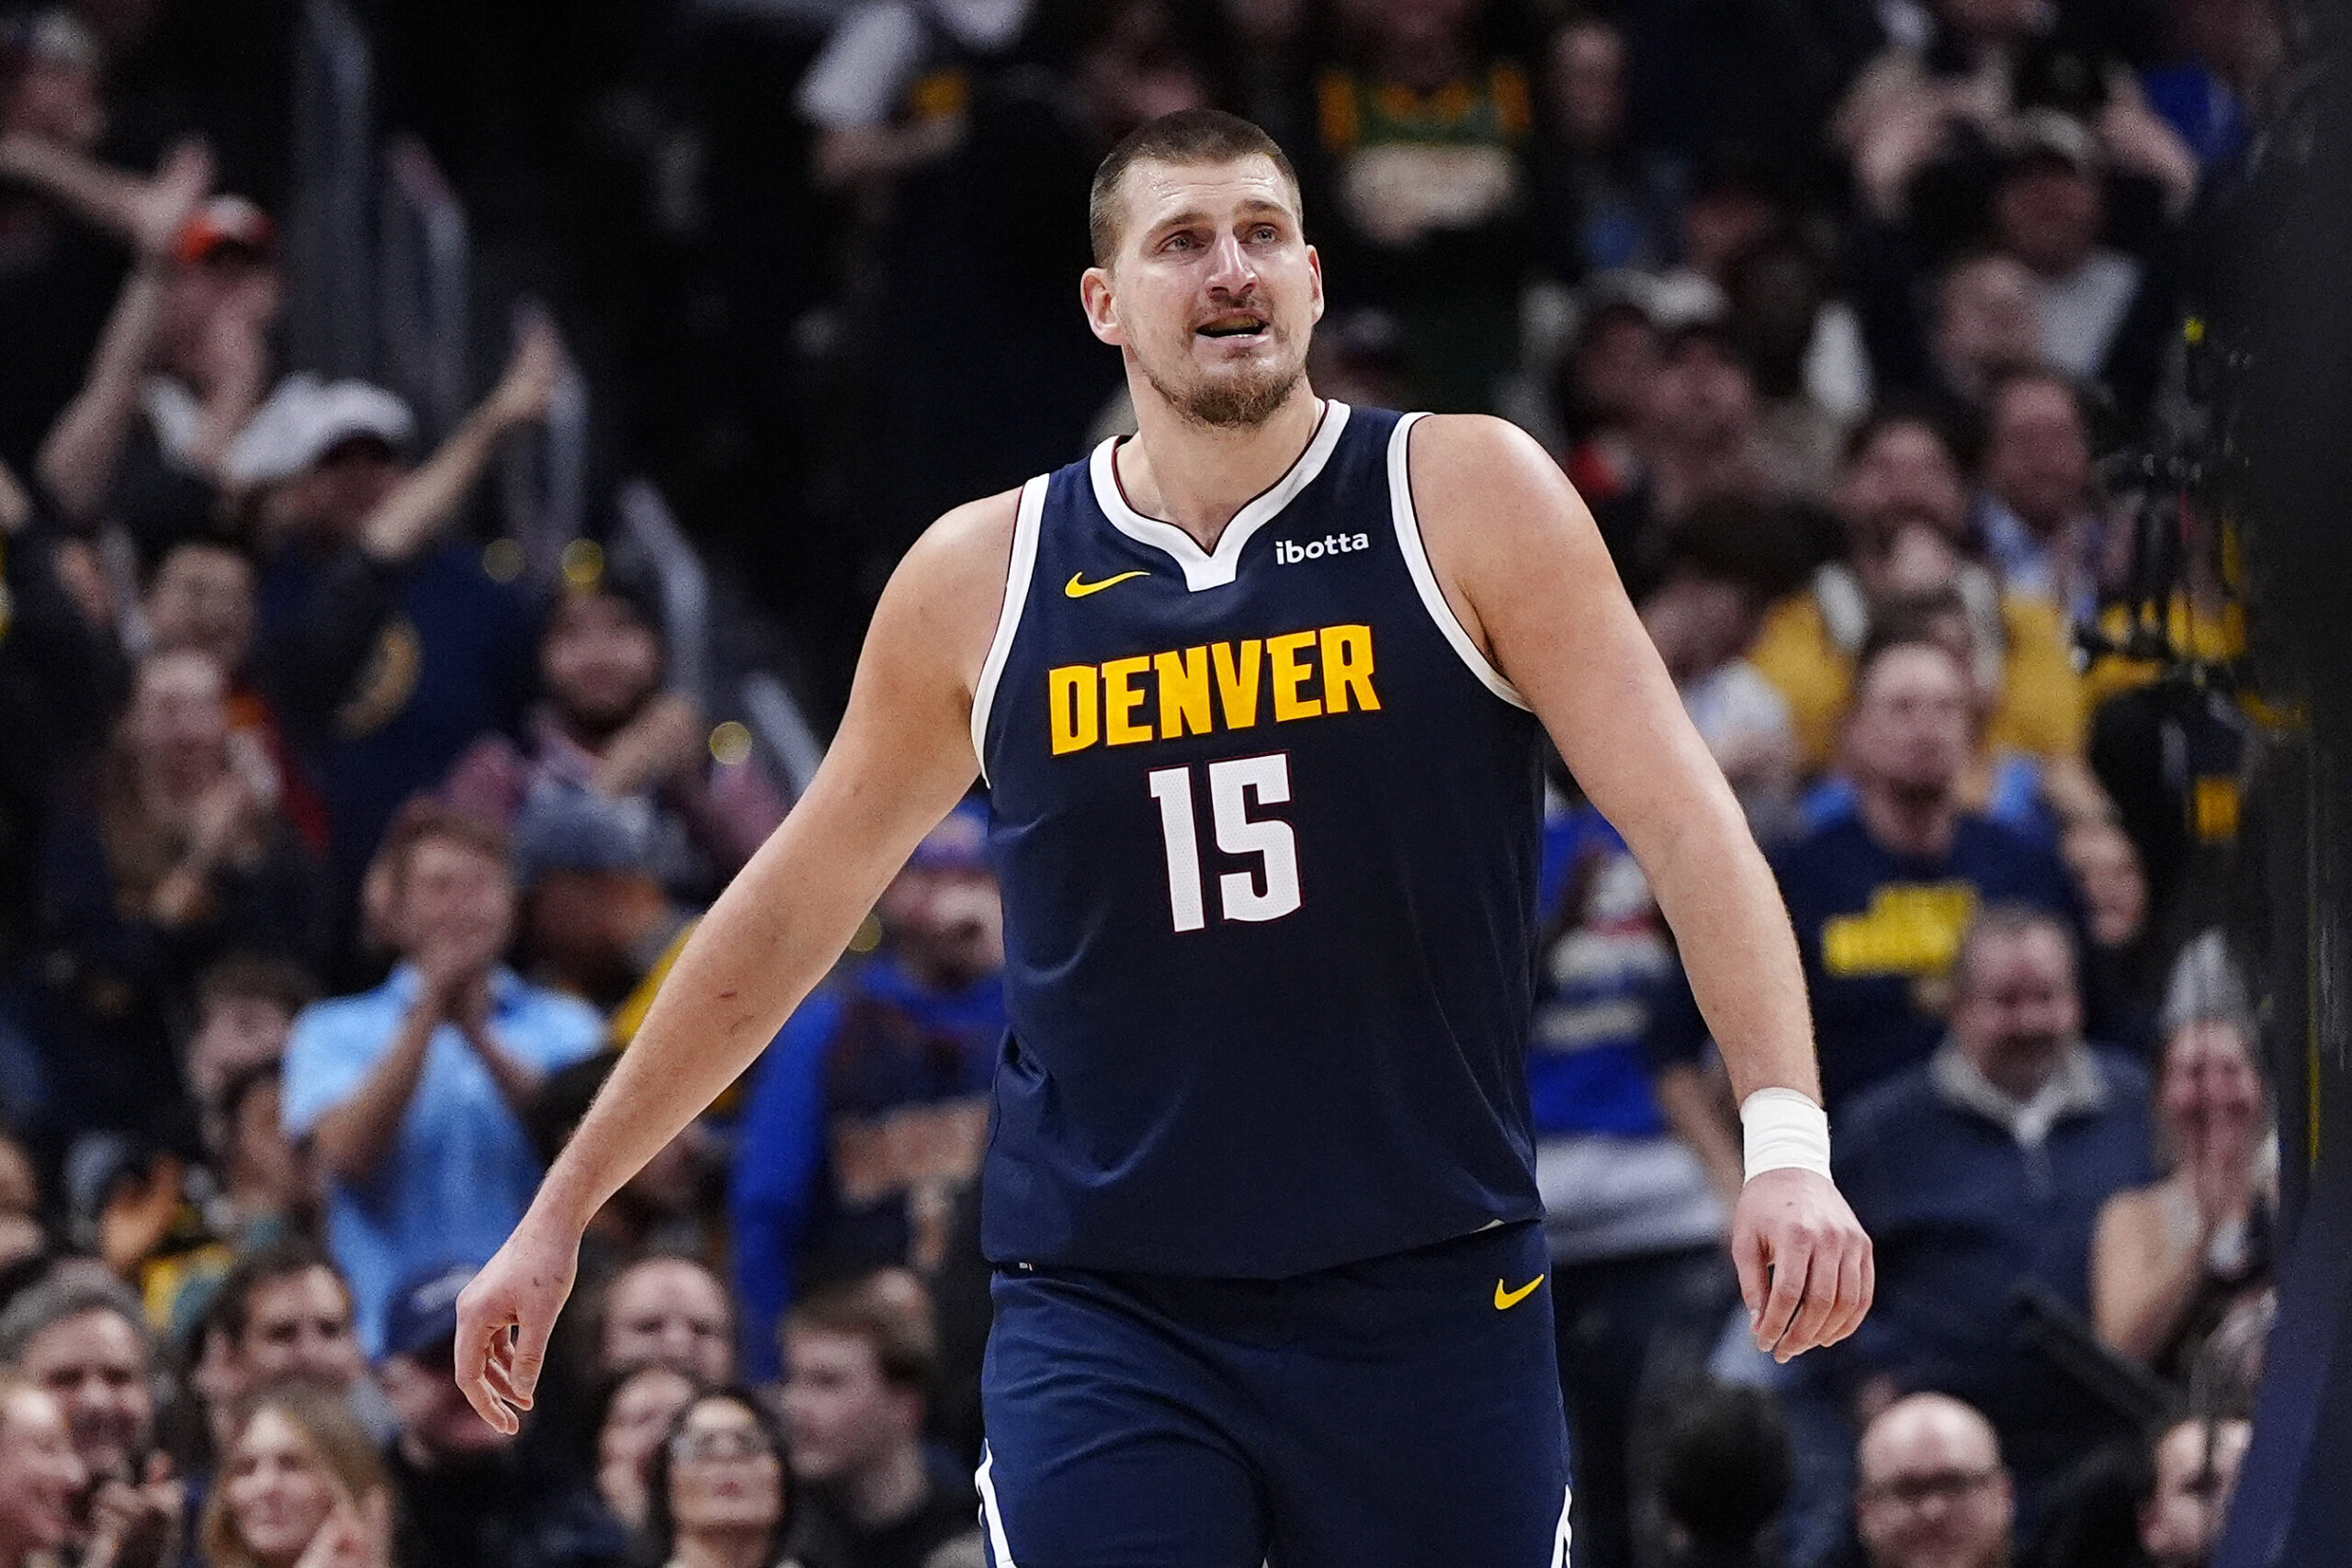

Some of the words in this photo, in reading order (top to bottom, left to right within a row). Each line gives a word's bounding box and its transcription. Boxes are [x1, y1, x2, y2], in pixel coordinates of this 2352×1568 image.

[1275, 533, 1369, 565] ibotta
[1048, 624, 1382, 756] DENVER
[1148, 753, 1302, 932] 15
